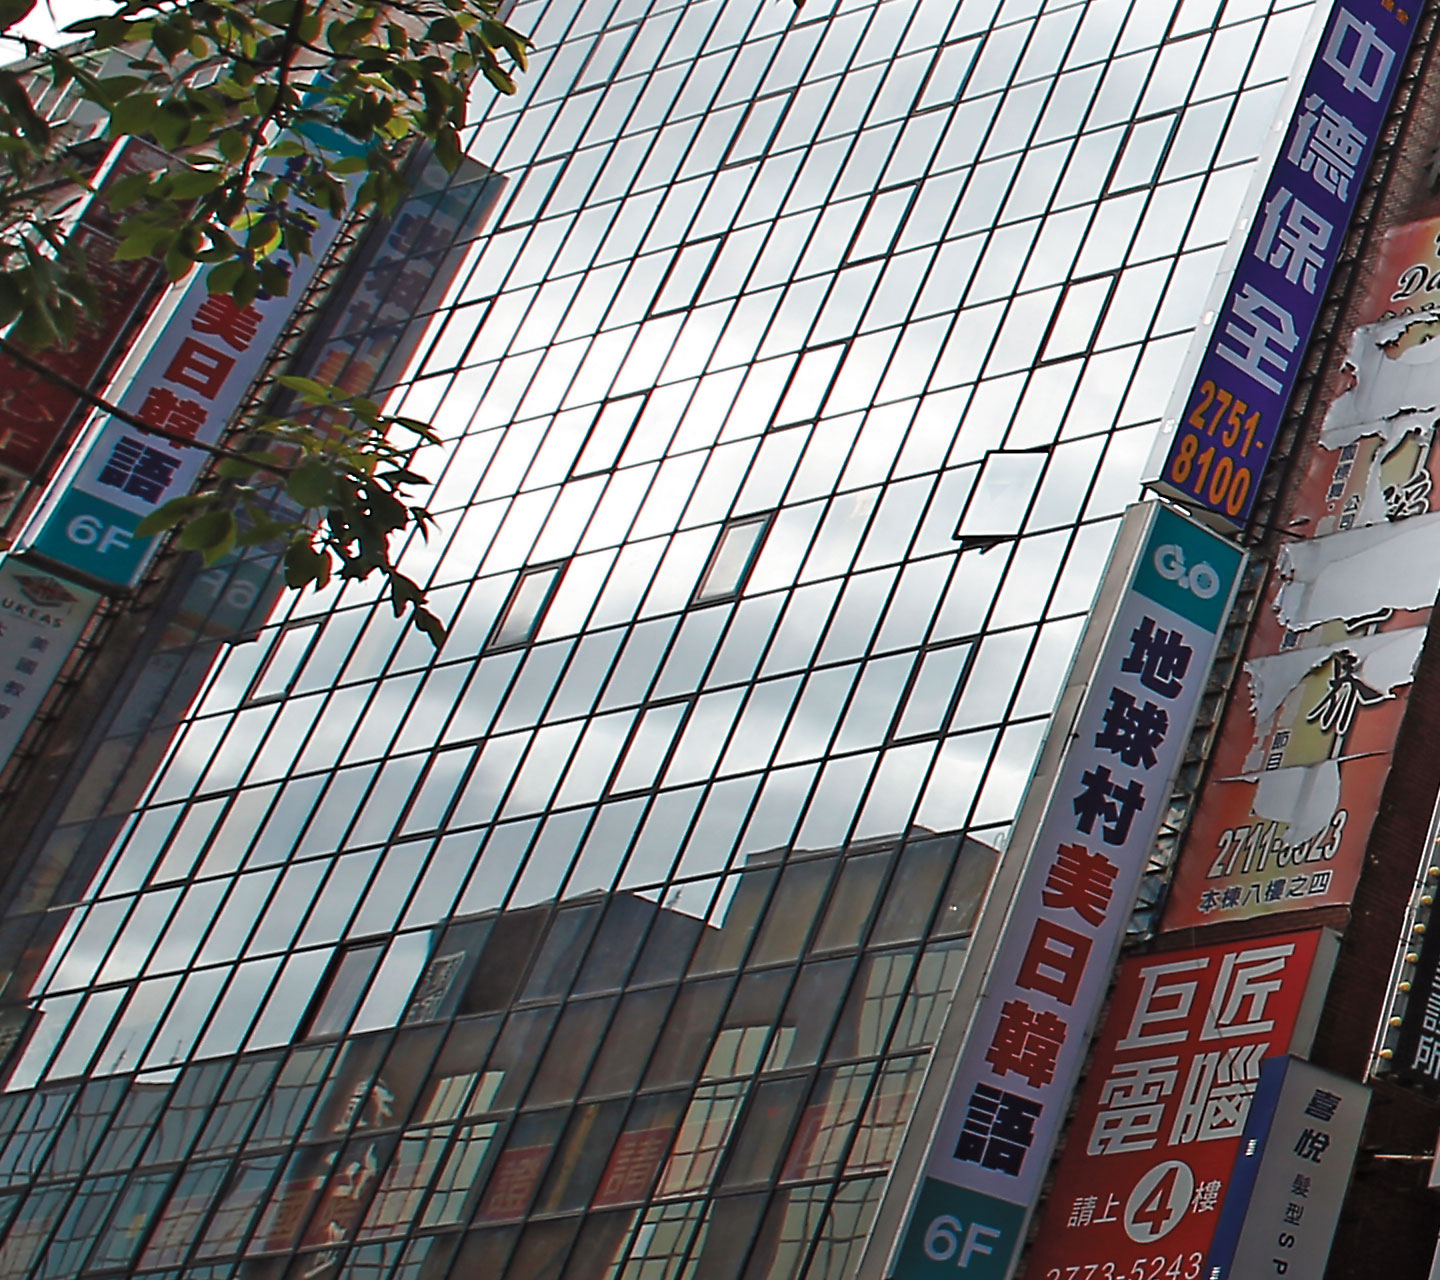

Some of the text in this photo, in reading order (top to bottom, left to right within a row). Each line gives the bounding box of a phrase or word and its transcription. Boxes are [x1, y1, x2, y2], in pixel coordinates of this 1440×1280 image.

[1213, 5, 1396, 397] 中德保全
[1170, 432, 1250, 517] 8100
[65, 515, 135, 556] 6F
[953, 615, 1195, 1181] 地球村美日韓語
[1197, 869, 1334, 914] 本棟八樓之四
[1115, 939, 1297, 1053] 巨匠
[1087, 1047, 1268, 1158] 電腦
[922, 1212, 1000, 1270] 6F
